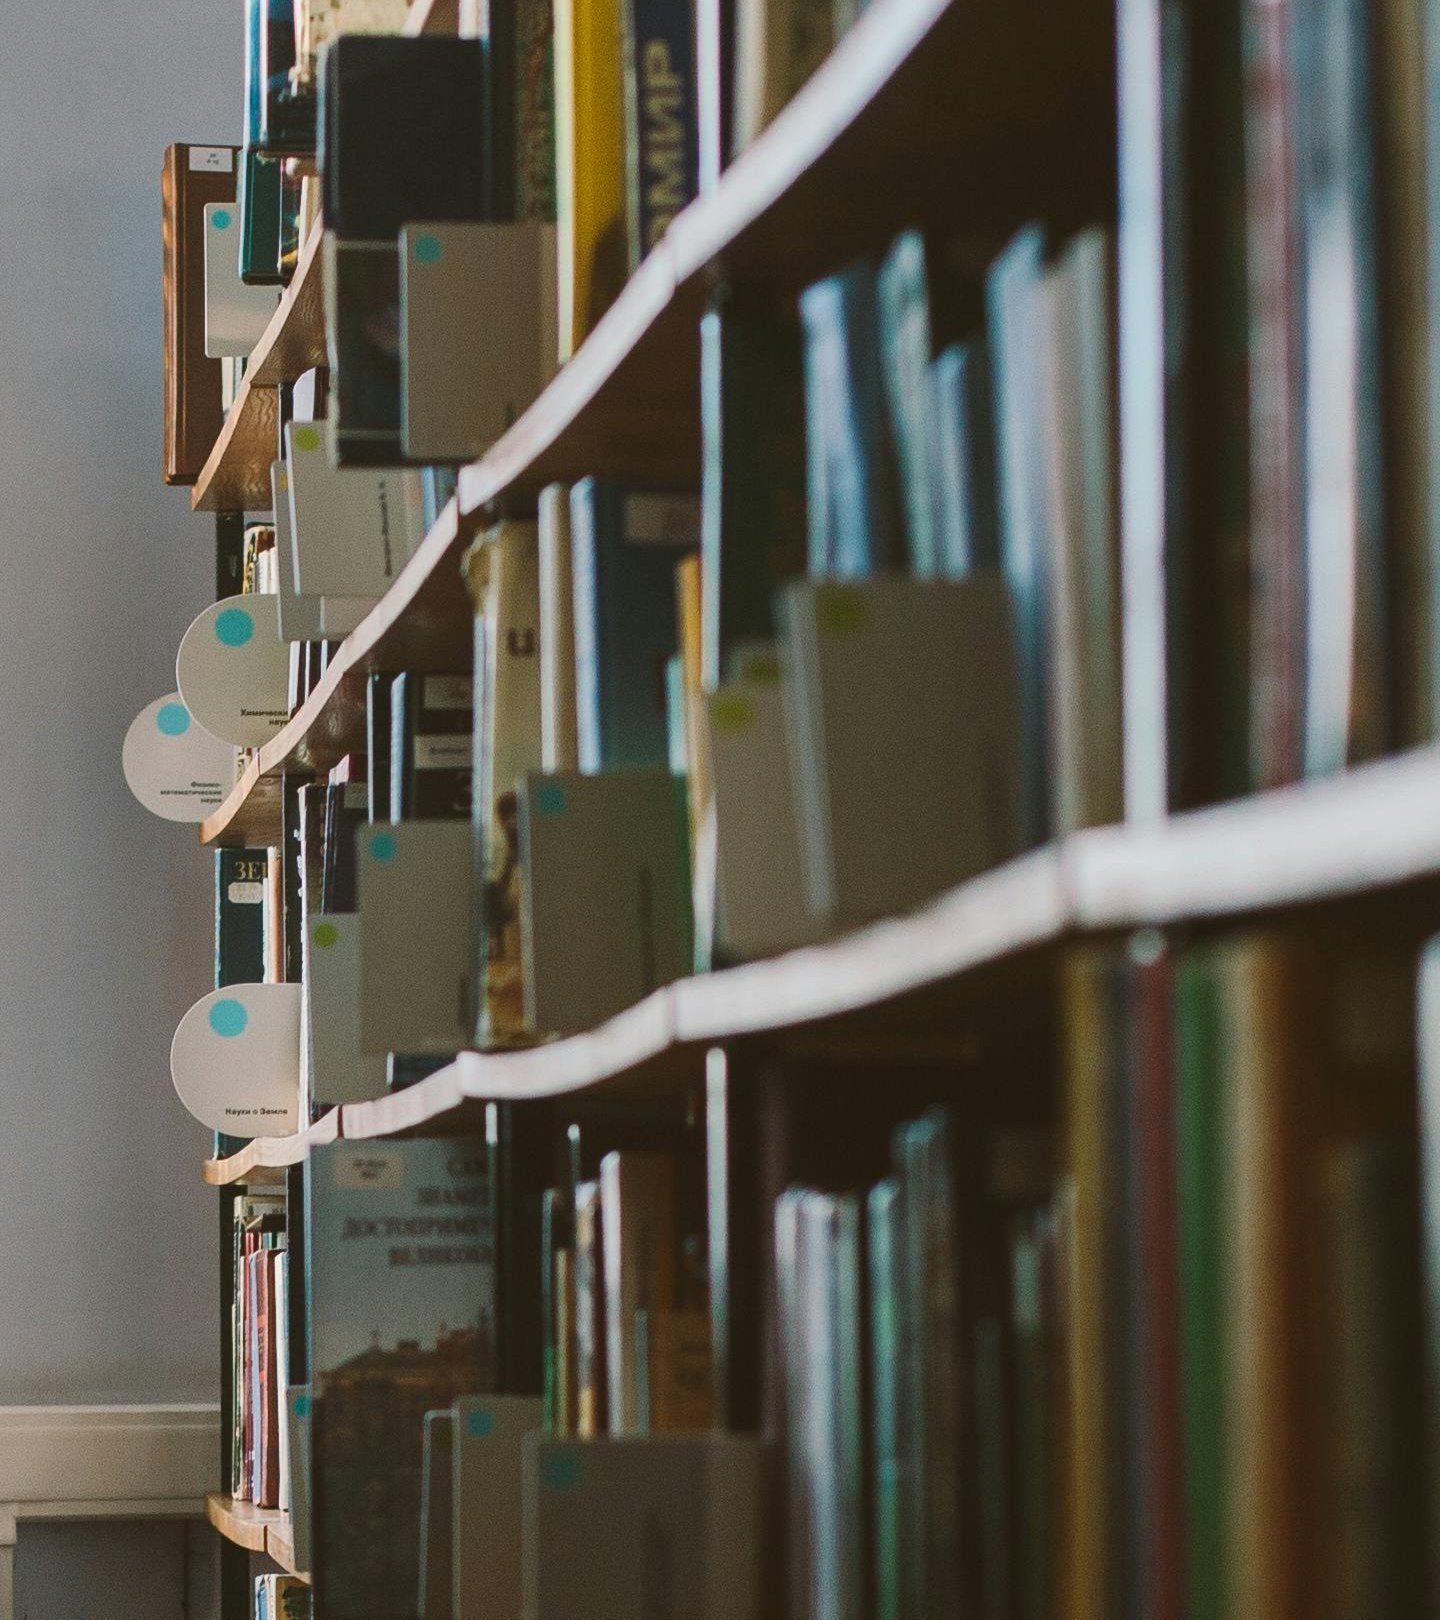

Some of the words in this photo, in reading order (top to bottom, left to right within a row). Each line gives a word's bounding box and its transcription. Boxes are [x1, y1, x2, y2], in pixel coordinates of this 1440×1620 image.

[240, 708, 288, 717] Химически
[225, 1107, 251, 1117] Науки
[260, 1107, 289, 1116] Земле
